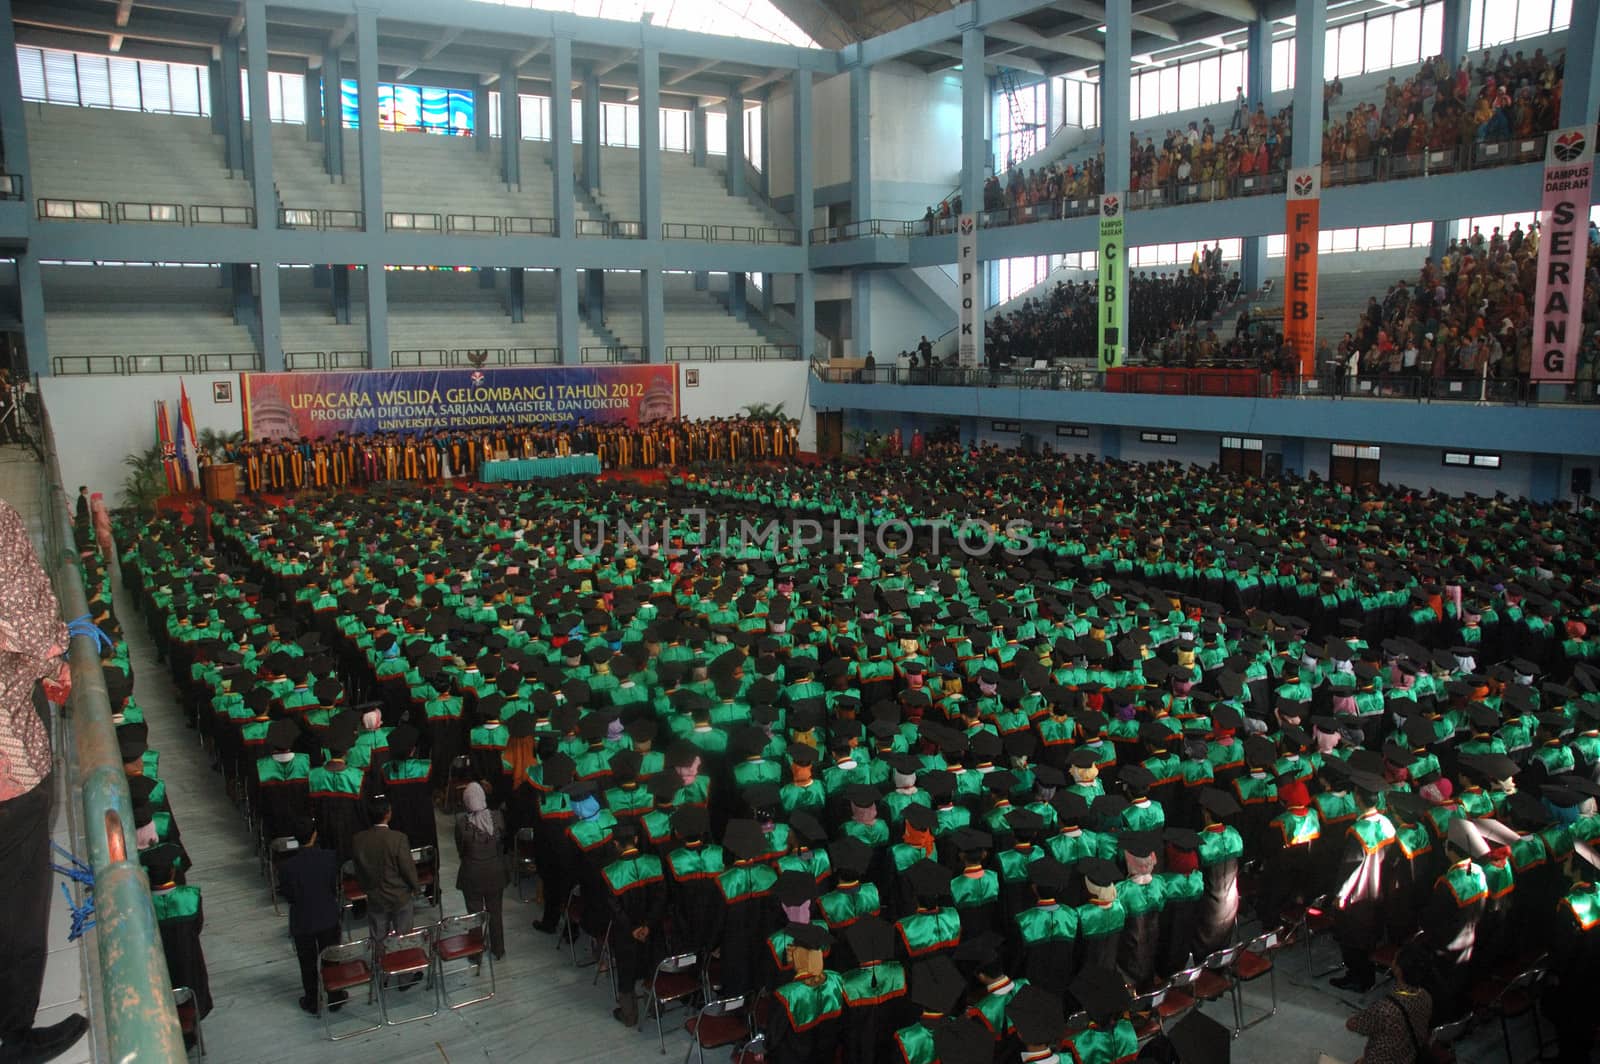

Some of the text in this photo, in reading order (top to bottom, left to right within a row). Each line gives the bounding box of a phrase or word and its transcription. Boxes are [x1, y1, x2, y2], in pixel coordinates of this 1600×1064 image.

[1545, 167, 1589, 181] KAMPUS
[1545, 178, 1589, 193] DAERAH
[1292, 212, 1311, 320] FPEB
[962, 246, 973, 335] FPOK
[1543, 201, 1575, 373] SERANG
[1104, 243, 1119, 365] CIBIU
[291, 392, 372, 409] UPACARA
[376, 389, 442, 406] WISUDA
[446, 386, 546, 404] GELOMBANG
[556, 384, 608, 399] TAHUN
[611, 383, 645, 398] 2012
[310, 407, 376, 422] PROGRAM
[378, 404, 438, 418] DIPLOMA,
[440, 401, 494, 417] SARJANA,
[557, 399, 582, 411] DAN
[584, 397, 630, 410] DOKTOR
[378, 411, 574, 430] UNIVERSITAS PENDIDIKAN INDONESIA
